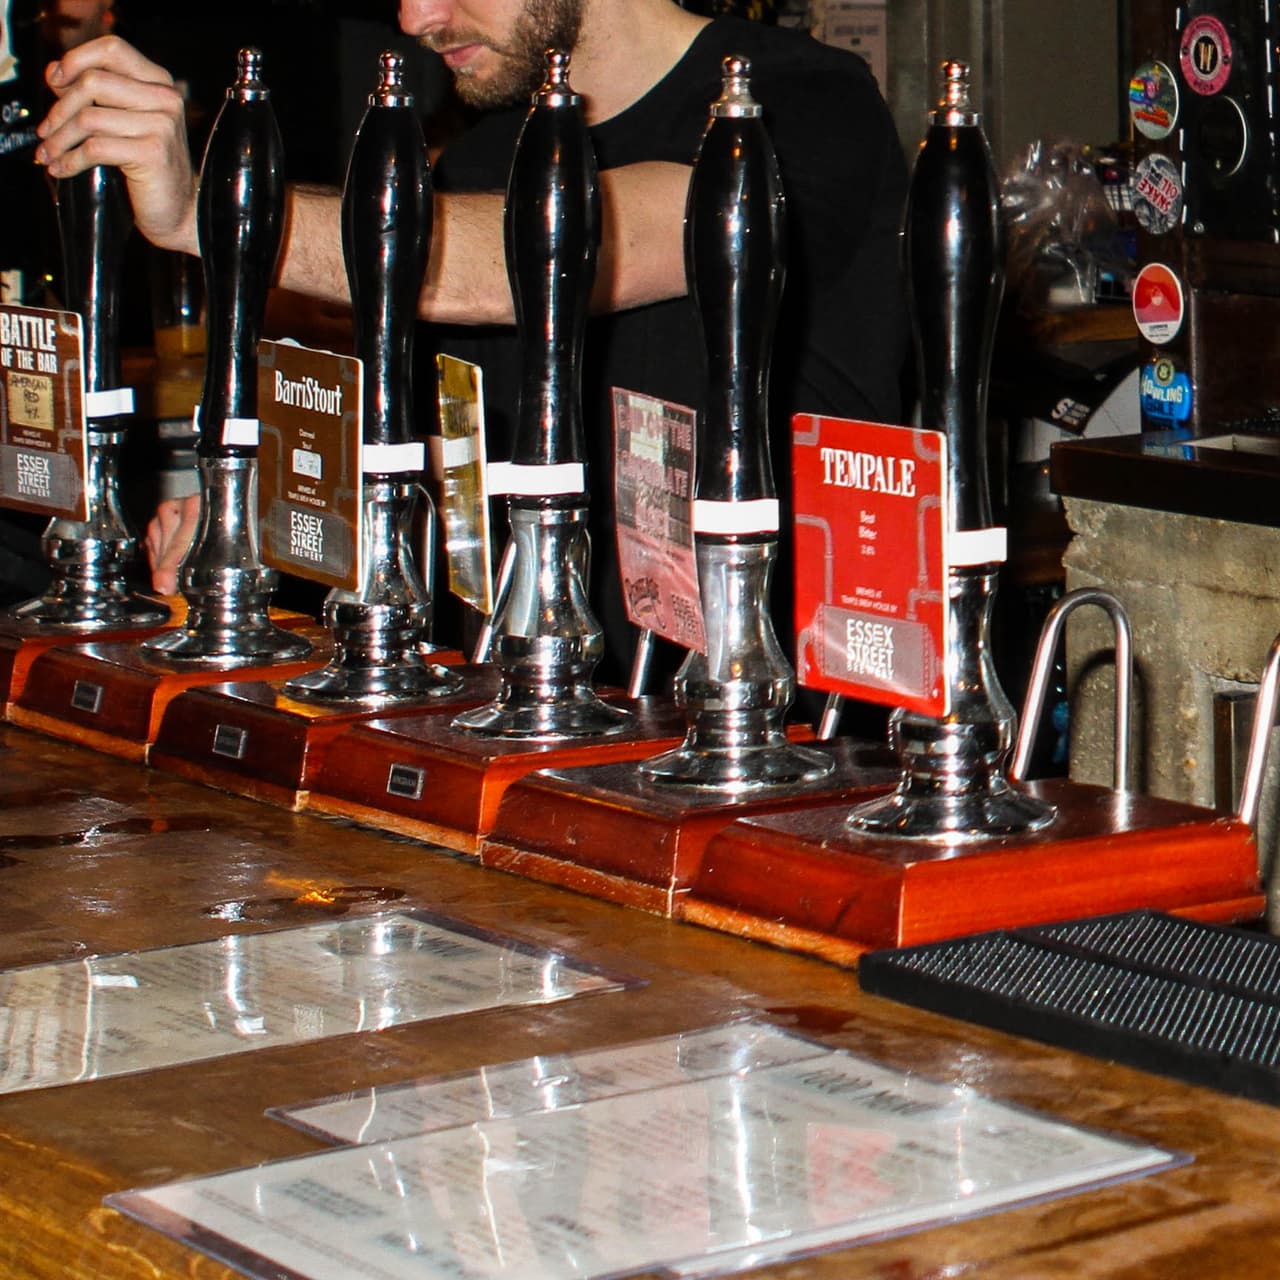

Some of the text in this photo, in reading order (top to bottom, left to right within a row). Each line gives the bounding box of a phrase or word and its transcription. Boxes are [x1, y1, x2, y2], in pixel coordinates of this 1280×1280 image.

[0, 312, 56, 352] BATTLE
[17, 348, 58, 374] THE BAR
[274, 370, 342, 417] BarriStout
[17, 453, 50, 475] ESSEX
[820, 448, 916, 497] TEMPALE
[291, 510, 323, 536] ESSEX
[291, 530, 323, 554] STREET
[846, 619, 894, 649] ESSEX
[847, 643, 894, 669] STREET
